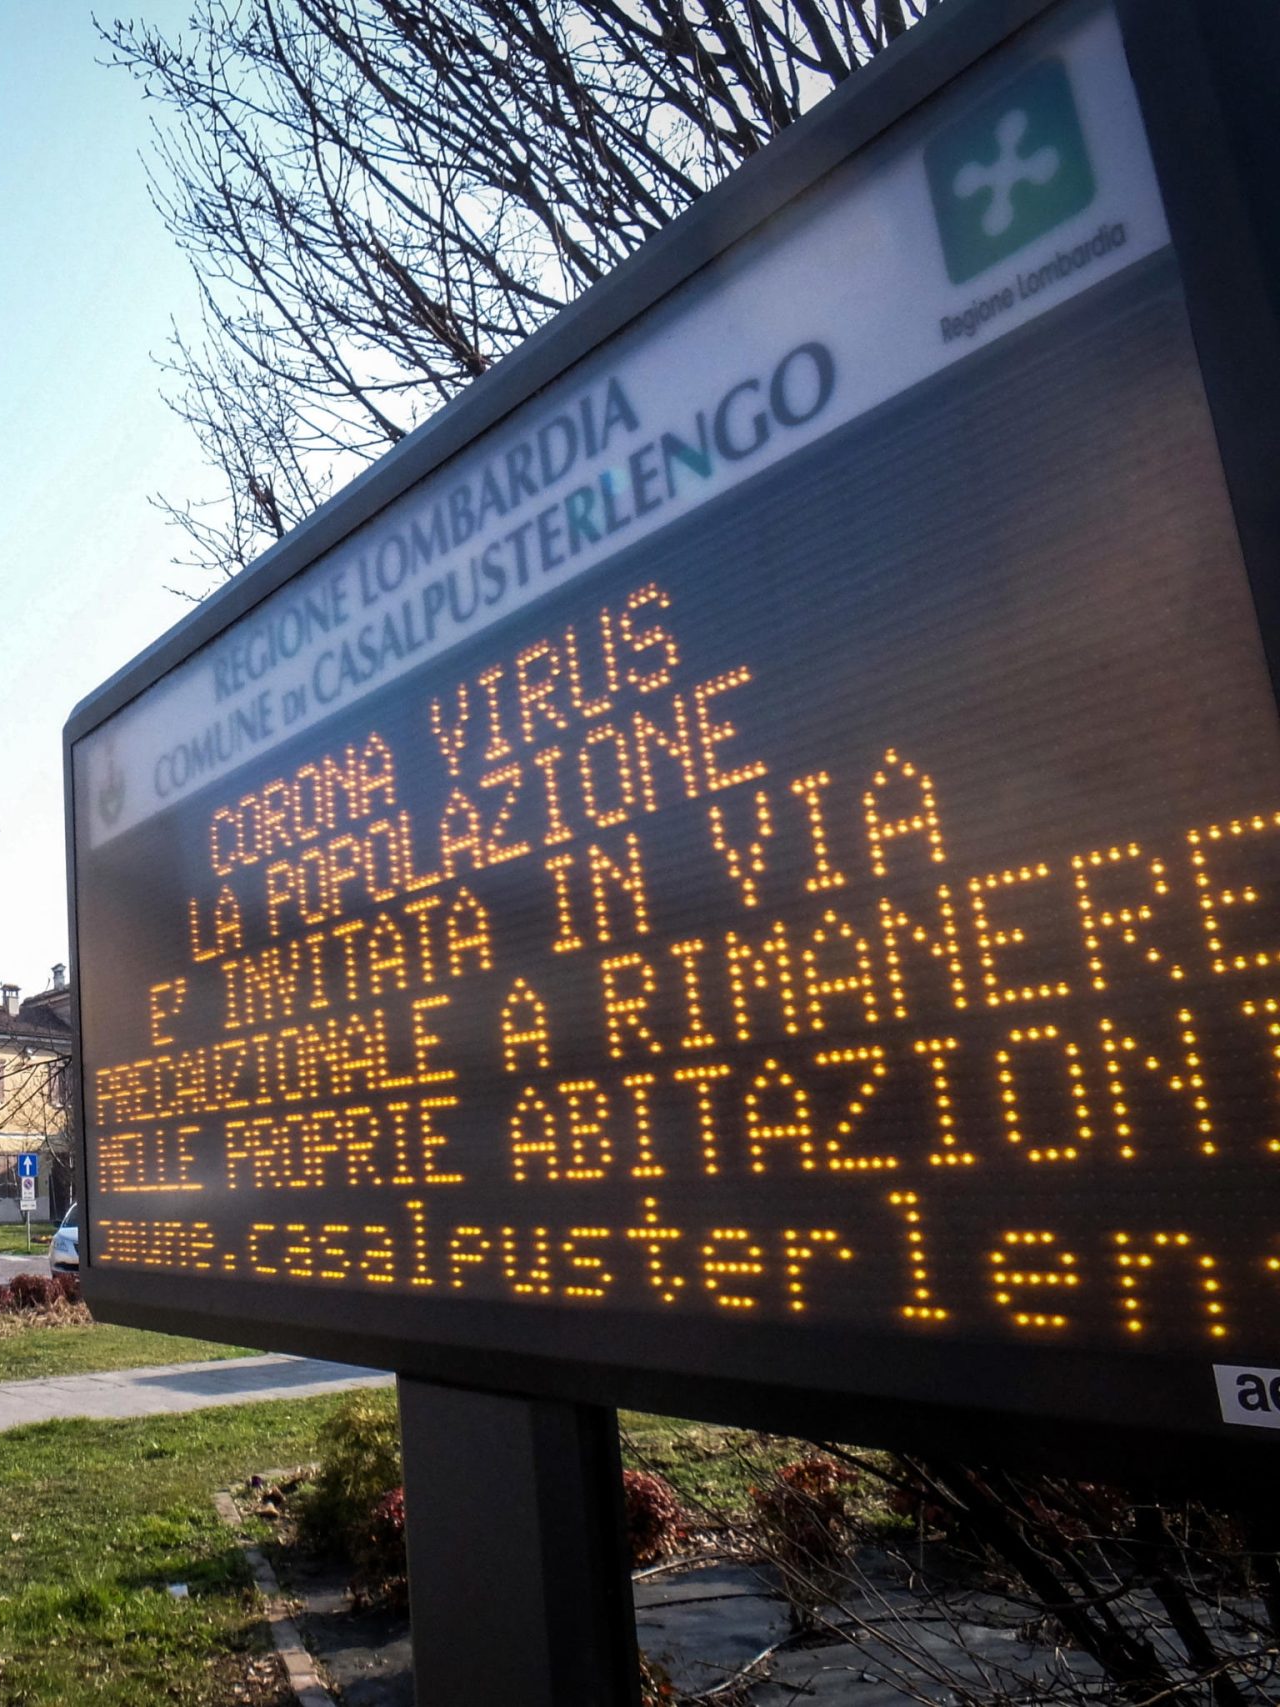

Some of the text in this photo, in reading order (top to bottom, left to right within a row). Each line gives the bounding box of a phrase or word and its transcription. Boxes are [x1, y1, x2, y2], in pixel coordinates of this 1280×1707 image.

[939, 222, 1127, 345] Regione Lombardia
[153, 691, 274, 798] COMUNE
[312, 341, 835, 704] CASALPUSTERLENGO
[211, 375, 639, 704] REGIONE LOMBARDIA
[189, 669, 768, 962] LA POPOLAZIONE
[210, 583, 679, 877] CORONA VIRUS
[95, 811, 1280, 1126] PRECAUZIONALE A RIMANERE
[222, 886, 493, 1030] INVITATA
[544, 832, 650, 953] IN
[709, 748, 947, 906] VIA
[97, 1125, 205, 1193] NELLE
[225, 1095, 464, 1190] PROPRIE
